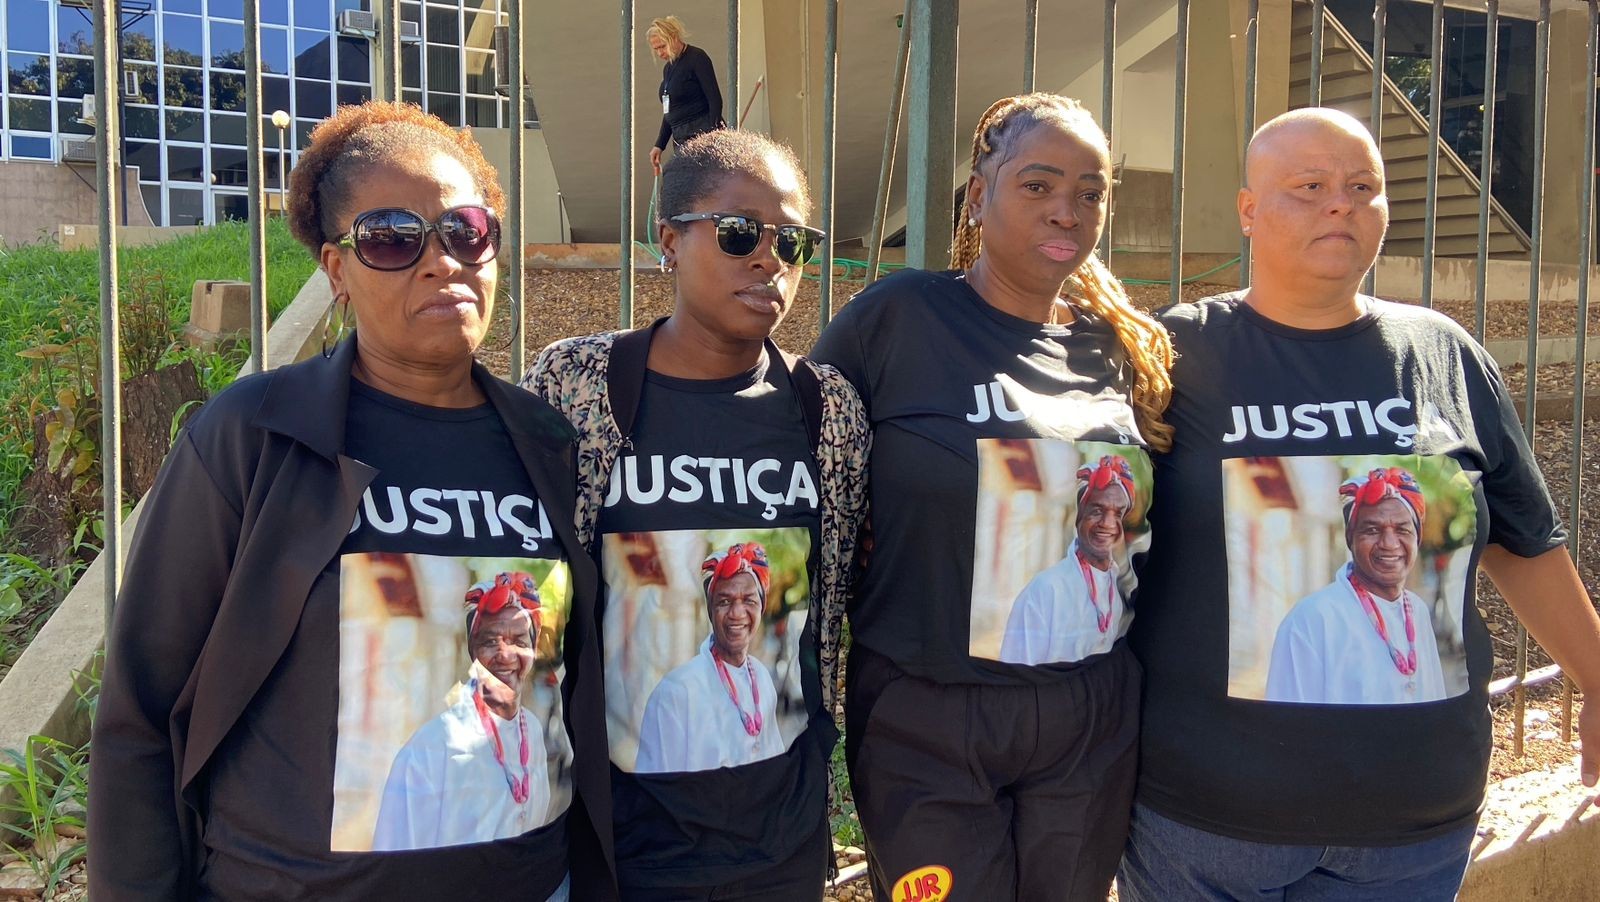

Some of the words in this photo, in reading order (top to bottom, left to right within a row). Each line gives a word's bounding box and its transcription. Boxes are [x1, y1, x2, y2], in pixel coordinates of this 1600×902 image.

[349, 486, 553, 551] USTIÇ
[604, 454, 819, 520] JUSTIÇA
[900, 873, 942, 902] JJR
